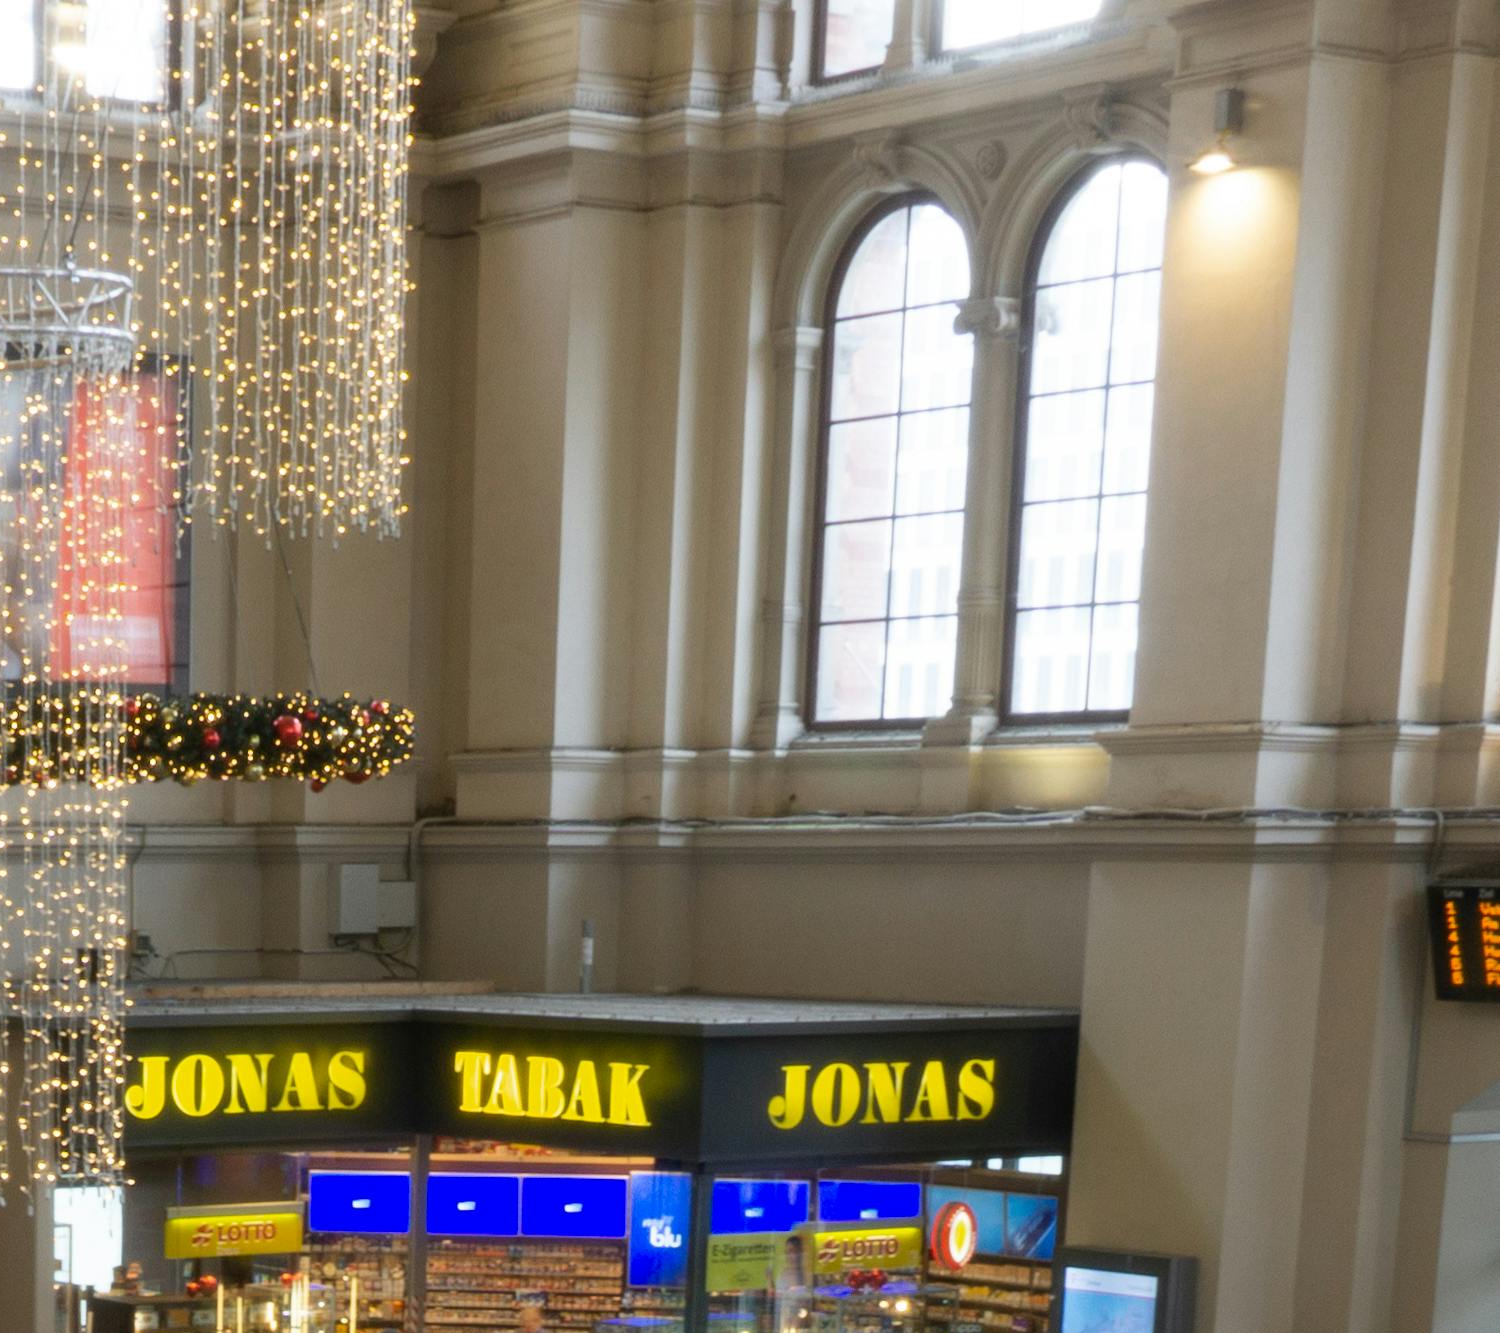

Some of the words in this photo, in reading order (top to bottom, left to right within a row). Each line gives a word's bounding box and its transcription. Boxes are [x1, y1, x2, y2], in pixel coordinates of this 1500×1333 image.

[125, 1050, 366, 1119] JONAS
[454, 1051, 652, 1126] TABAK
[768, 1059, 996, 1130] JONAS
[217, 1220, 277, 1244] LOTTO
[841, 1236, 899, 1259] LOTTO
